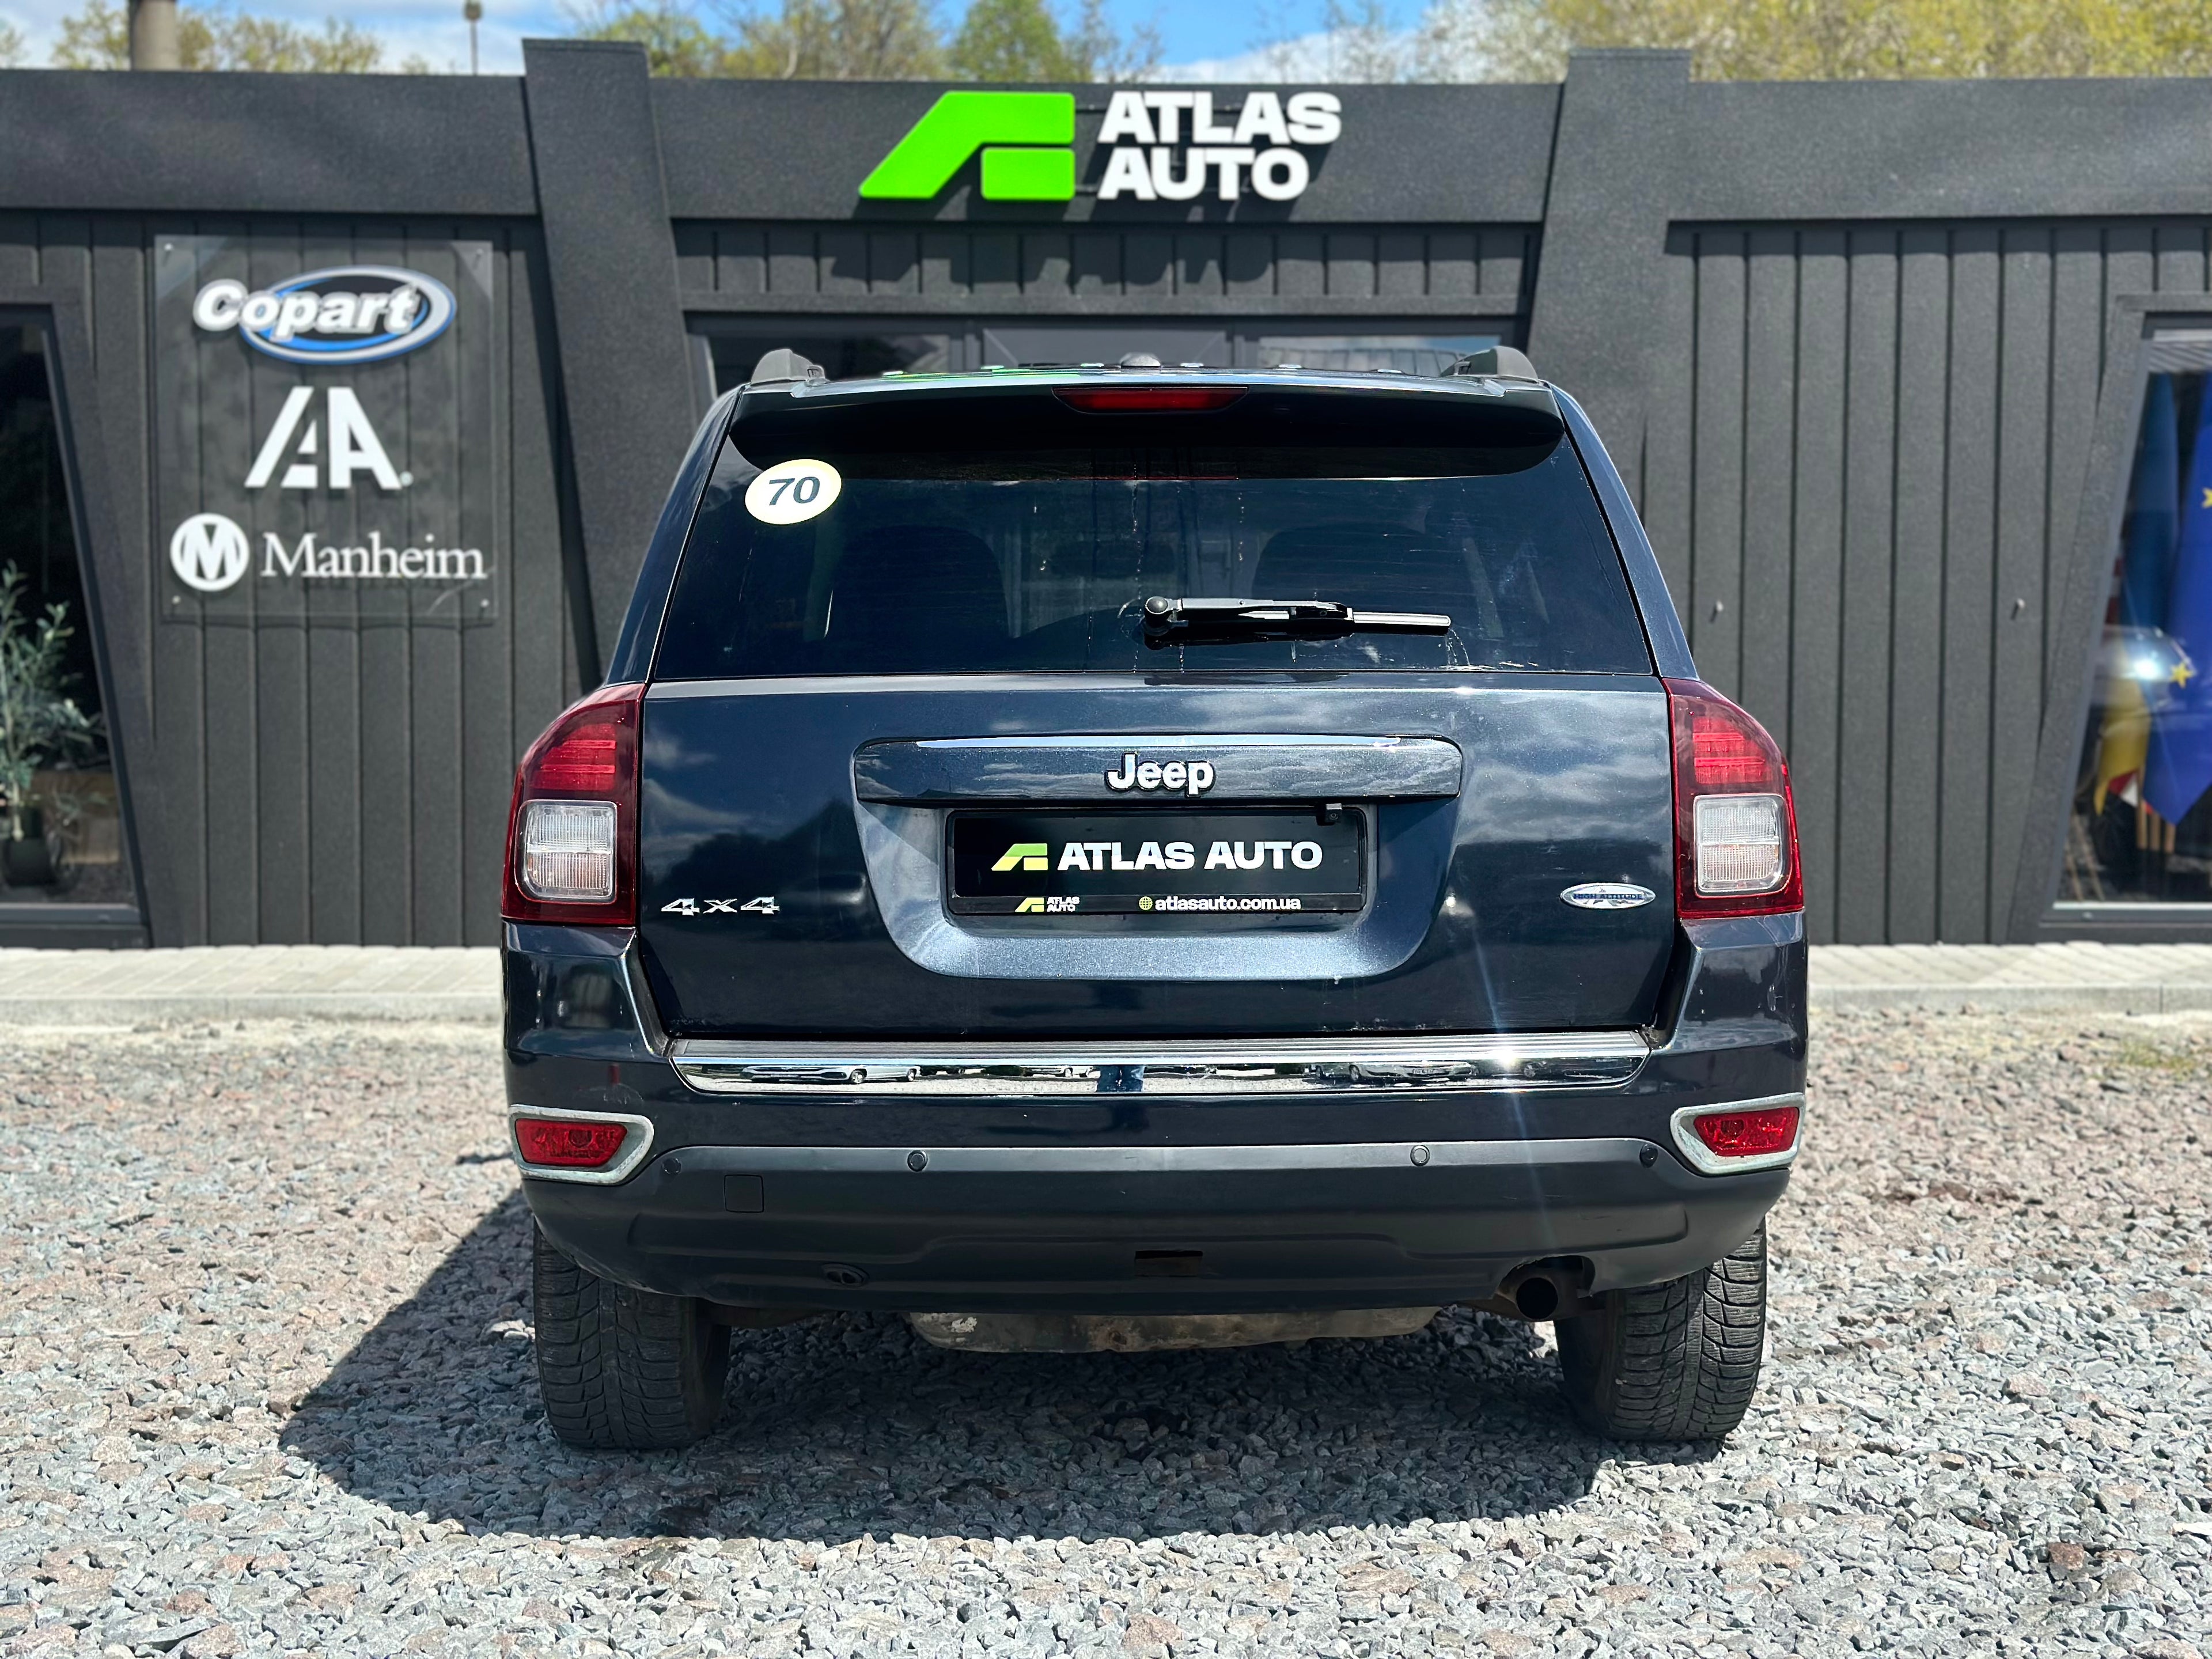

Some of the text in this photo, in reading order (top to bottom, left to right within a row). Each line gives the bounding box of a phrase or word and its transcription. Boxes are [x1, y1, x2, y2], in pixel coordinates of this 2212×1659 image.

[1097, 90, 1342, 143] ATLAS
[1097, 147, 1309, 200] AUTO
[193, 278, 419, 343] Copart
[768, 476, 820, 506] 70
[261, 531, 488, 579] Manheim
[1105, 752, 1216, 797] Jeep
[1058, 840, 1323, 871] ATLAS AUTO
[1046, 896, 1080, 904] ATLAS
[1154, 896, 1302, 911] atlasauto.com.ua
